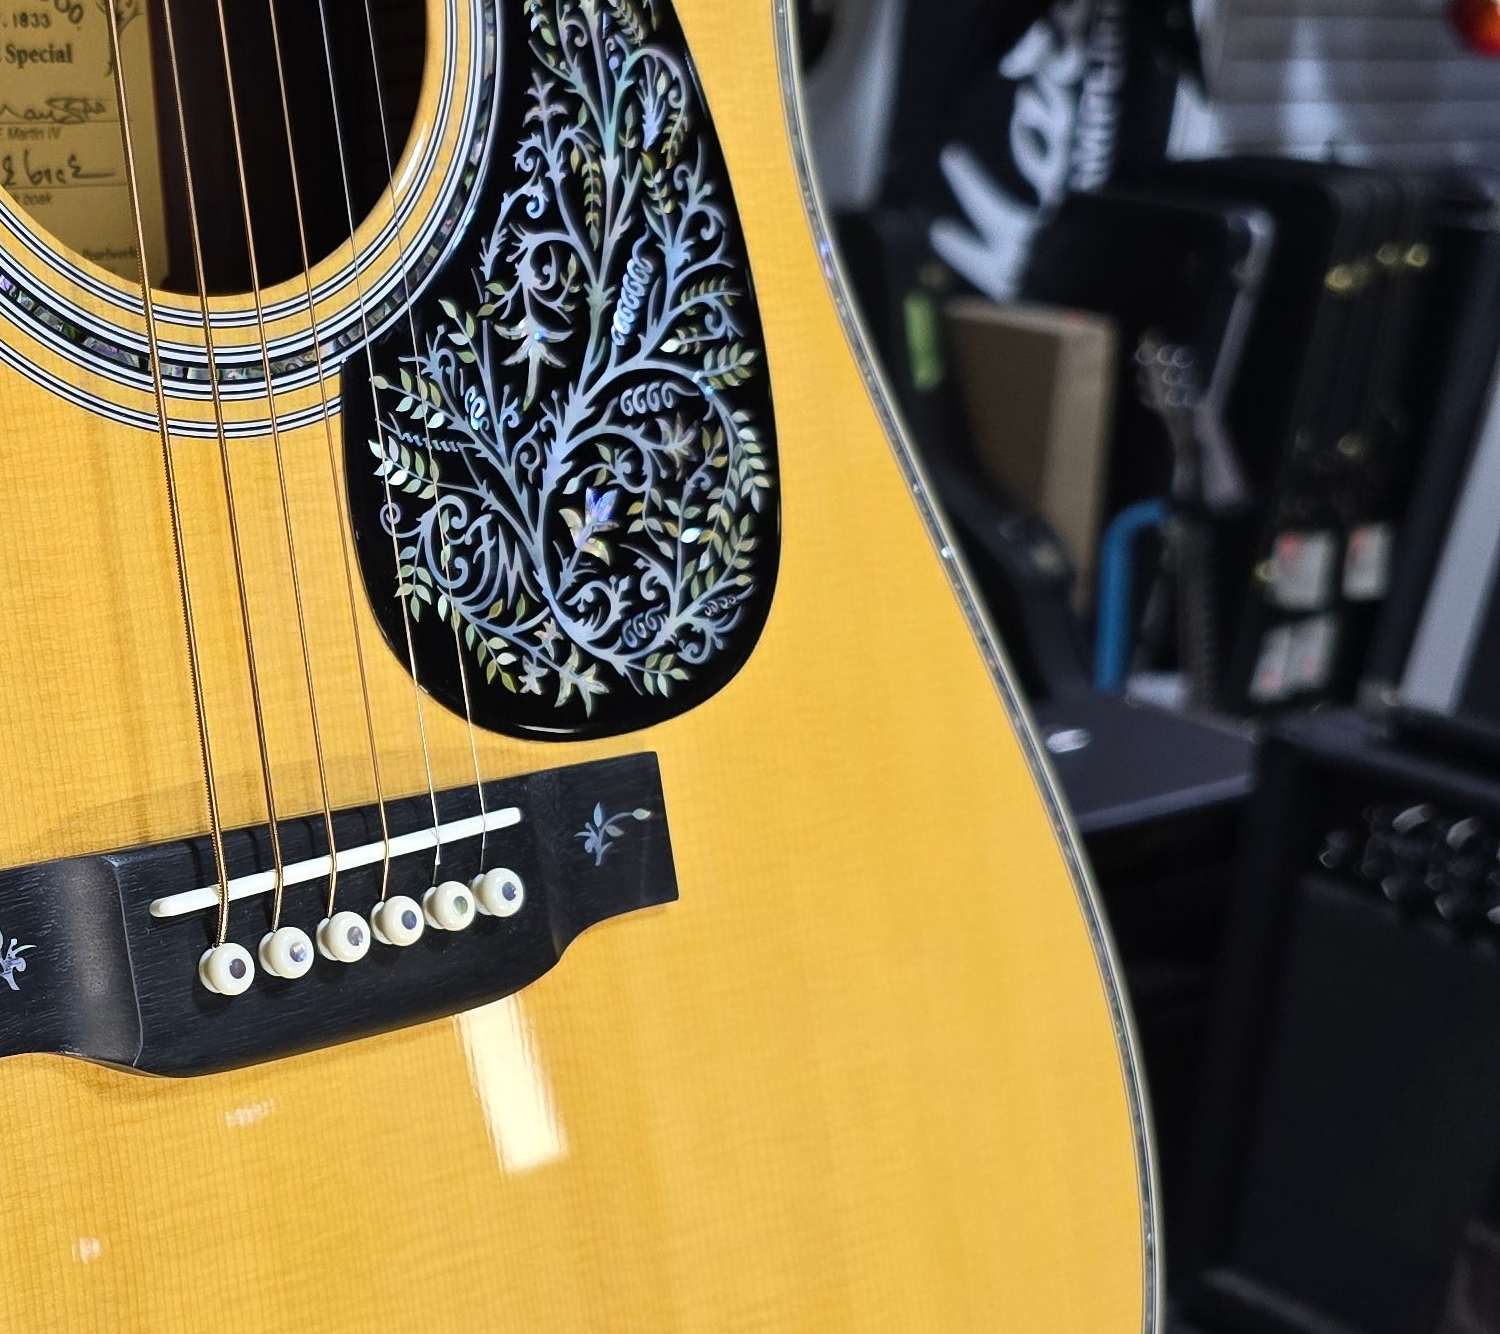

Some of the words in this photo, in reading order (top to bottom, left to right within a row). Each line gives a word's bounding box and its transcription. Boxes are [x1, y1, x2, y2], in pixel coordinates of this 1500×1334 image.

[13, 12, 51, 28] 1833
[5, 42, 73, 68] Special
[7, 126, 45, 141] Martin
